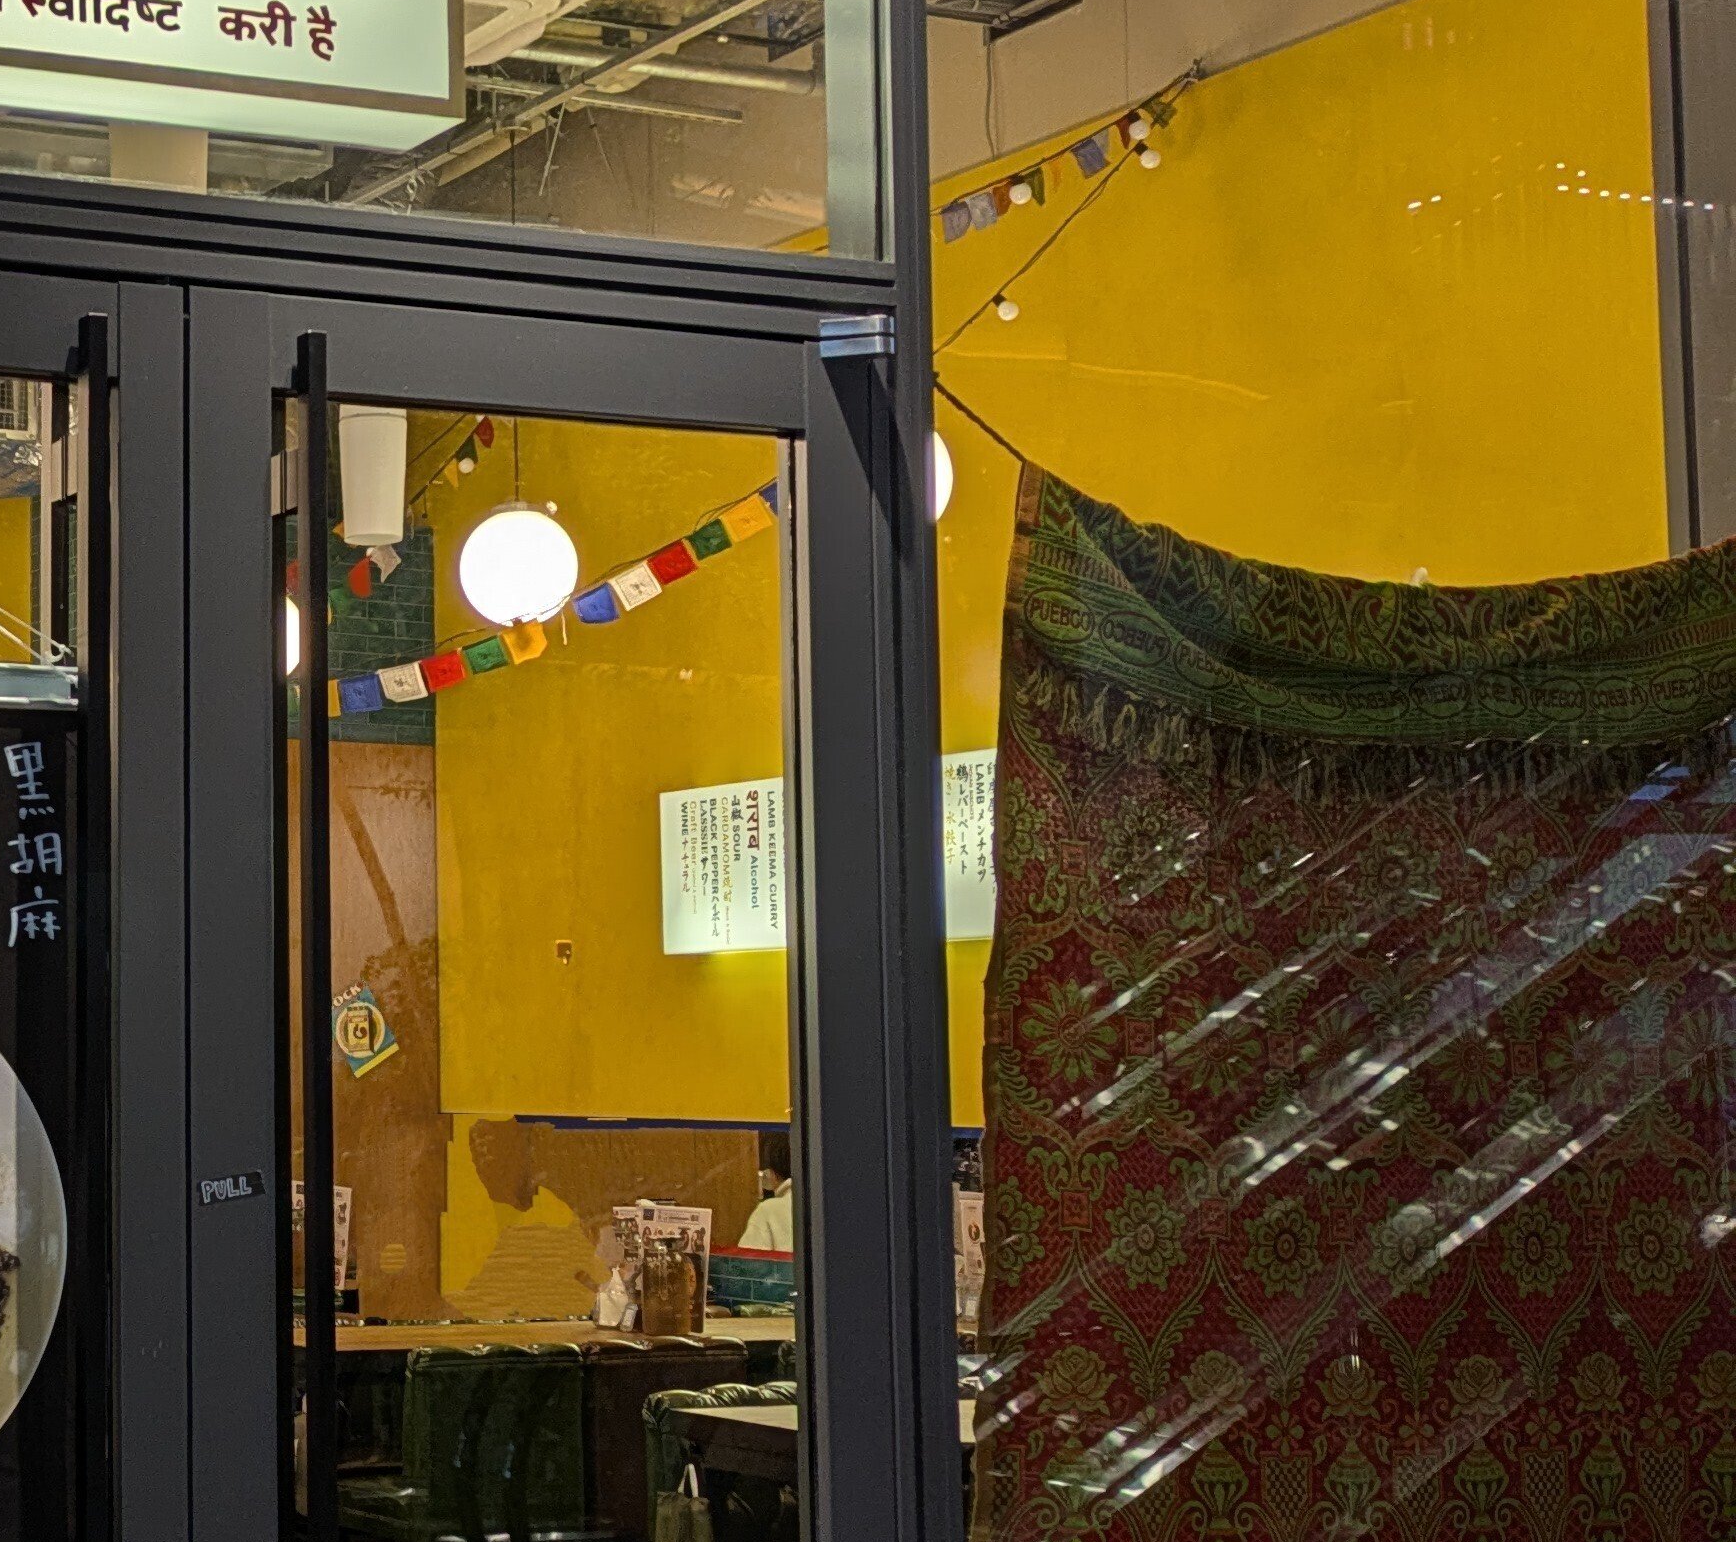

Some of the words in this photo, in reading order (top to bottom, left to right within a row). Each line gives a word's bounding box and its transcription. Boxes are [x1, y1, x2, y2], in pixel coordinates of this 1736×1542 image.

[217, 0, 296, 50] करी
[304, 3, 339, 61] है
[975, 763, 985, 805] LAMB
[681, 801, 689, 836] WINE
[709, 798, 718, 841] BLACK
[767, 791, 776, 828] LAMB
[4, 741, 63, 948] 黒胡麻
[732, 825, 741, 862] SOUR
[767, 833, 777, 879] KEEMA
[750, 855, 759, 909] Alcohol
[769, 884, 780, 930] CURRY
[201, 1175, 253, 1204] PULL
